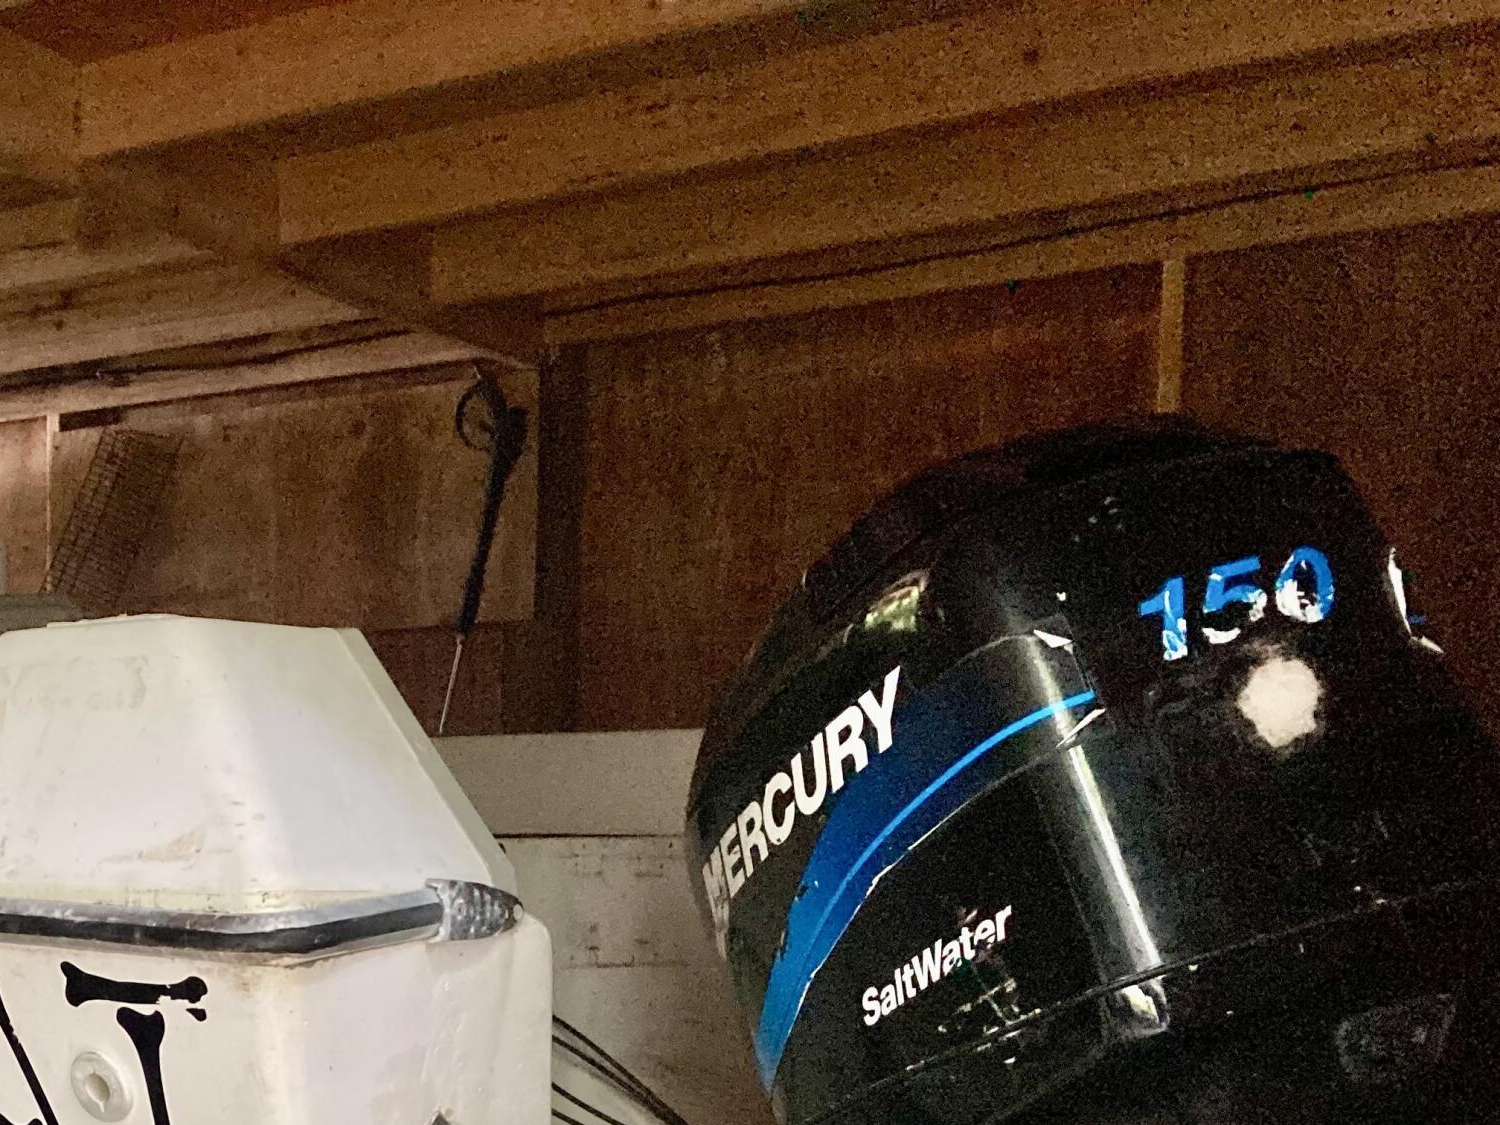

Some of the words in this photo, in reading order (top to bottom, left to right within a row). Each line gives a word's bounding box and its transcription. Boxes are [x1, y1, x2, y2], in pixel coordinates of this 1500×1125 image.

[1137, 544, 1336, 662] 150
[701, 664, 902, 928] MERCURY
[861, 904, 1013, 1027] SaltWater
